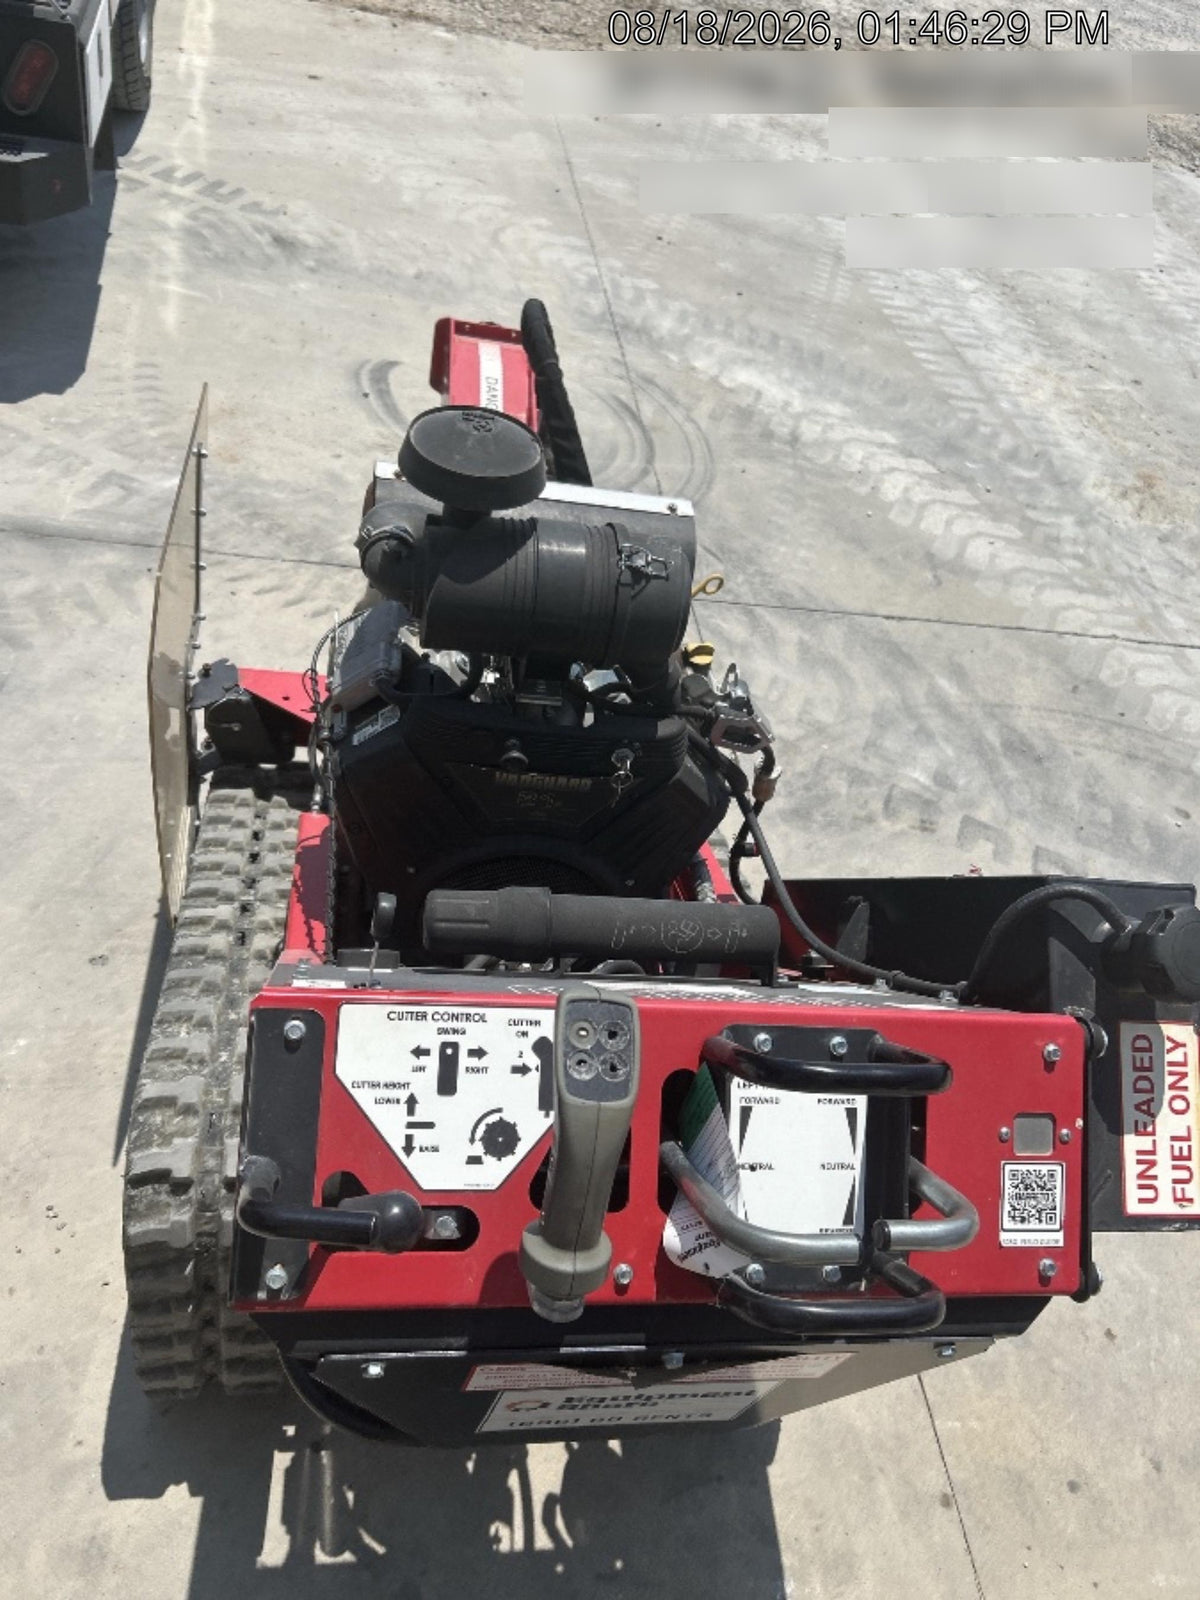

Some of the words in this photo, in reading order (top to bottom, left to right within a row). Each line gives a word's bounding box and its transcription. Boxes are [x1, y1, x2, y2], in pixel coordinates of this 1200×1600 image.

[387, 1011, 428, 1023] CUTTER
[431, 1012, 488, 1024] CONTROL
[1166, 1035, 1191, 1116] ONLY
[1131, 1034, 1159, 1205] UNLEADED
[1170, 1125, 1195, 1204] FUEL
